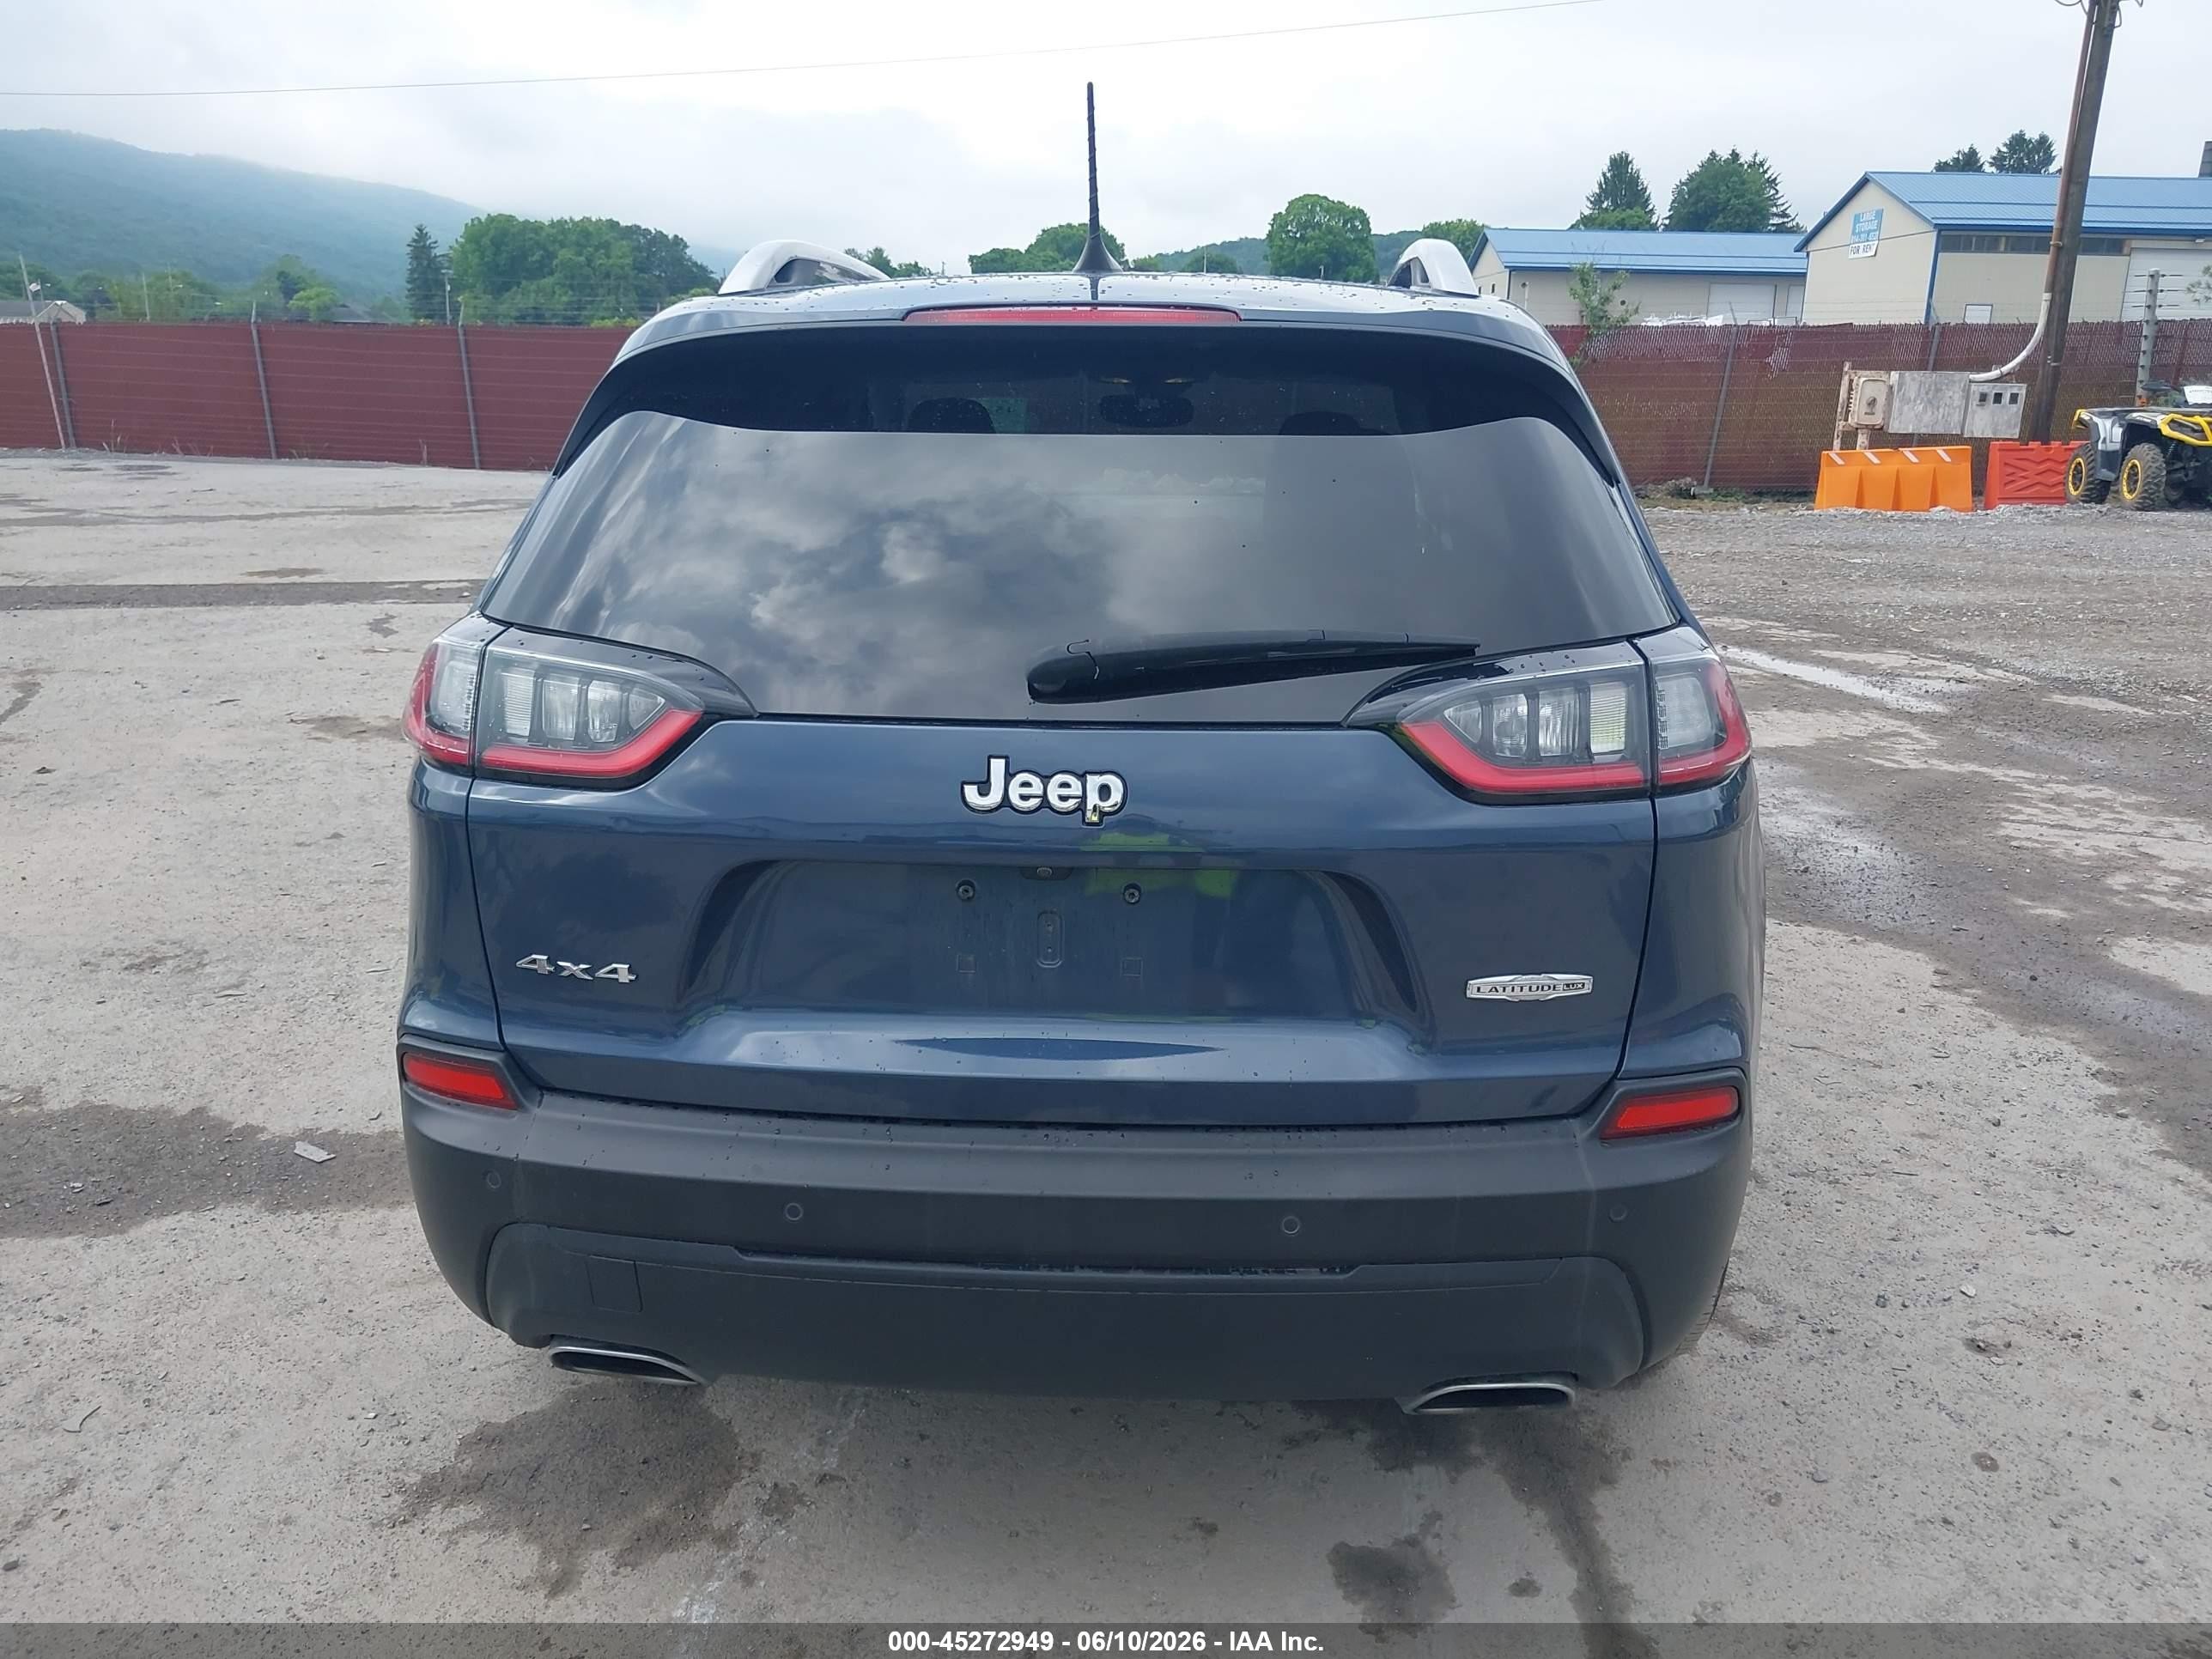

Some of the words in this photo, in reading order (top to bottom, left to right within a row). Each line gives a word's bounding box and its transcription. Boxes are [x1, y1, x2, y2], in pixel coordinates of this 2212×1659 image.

[1856, 220, 1878, 233] STORAGE
[1850, 246, 1860, 254] FOR
[1862, 244, 1875, 252] RENT
[962, 756, 1127, 825] Jeep
[515, 954, 637, 983] 4x4
[1476, 982, 1562, 994] LATITUDE
[1563, 982, 1584, 991] LUX
